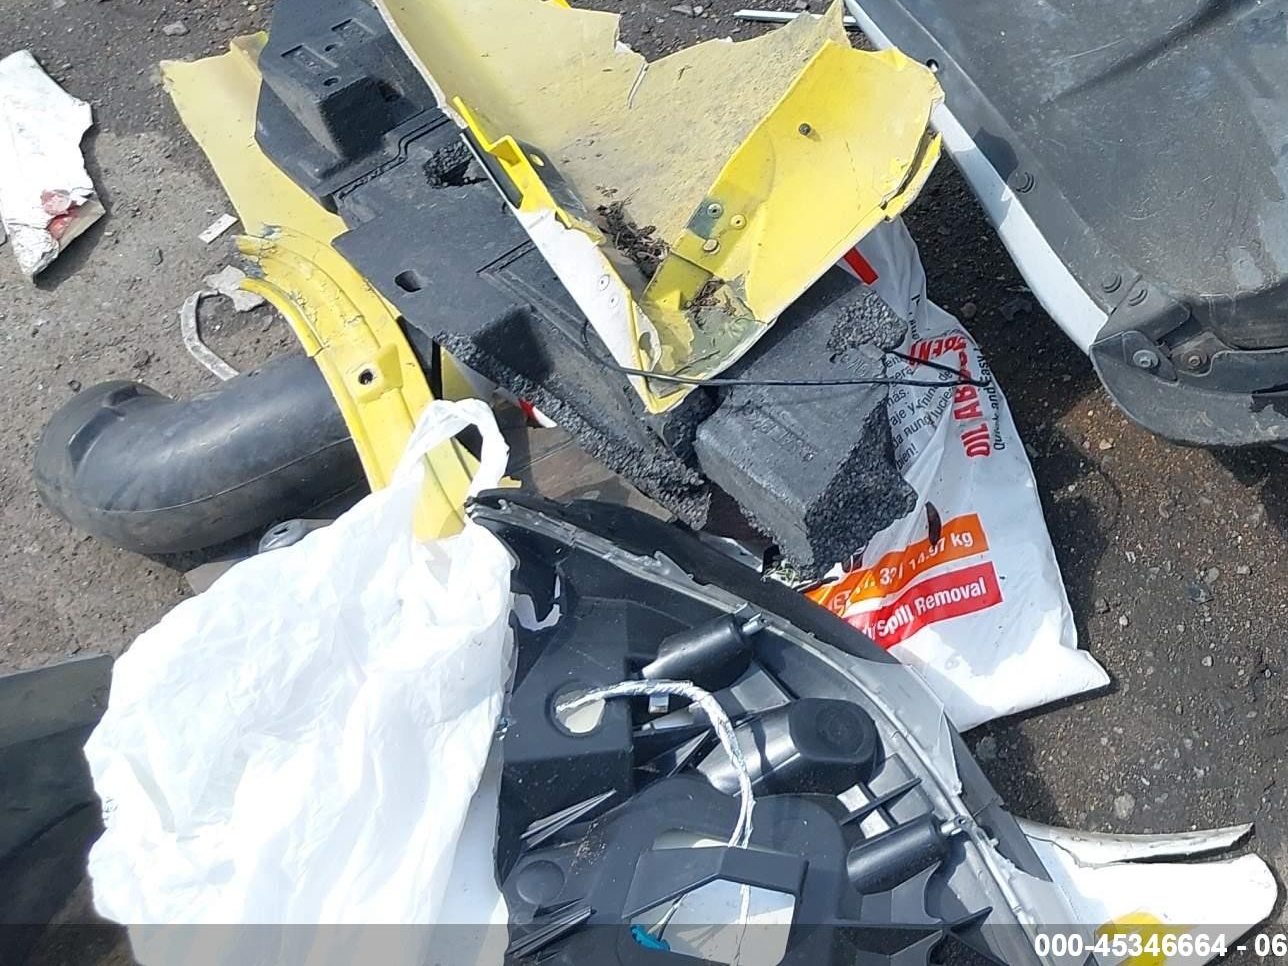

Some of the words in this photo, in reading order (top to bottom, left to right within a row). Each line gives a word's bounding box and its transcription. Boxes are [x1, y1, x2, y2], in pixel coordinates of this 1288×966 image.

[984, 387, 1000, 412] and
[961, 423, 991, 458] OIL
[950, 531, 974, 548] kg
[914, 576, 988, 617] Removal
